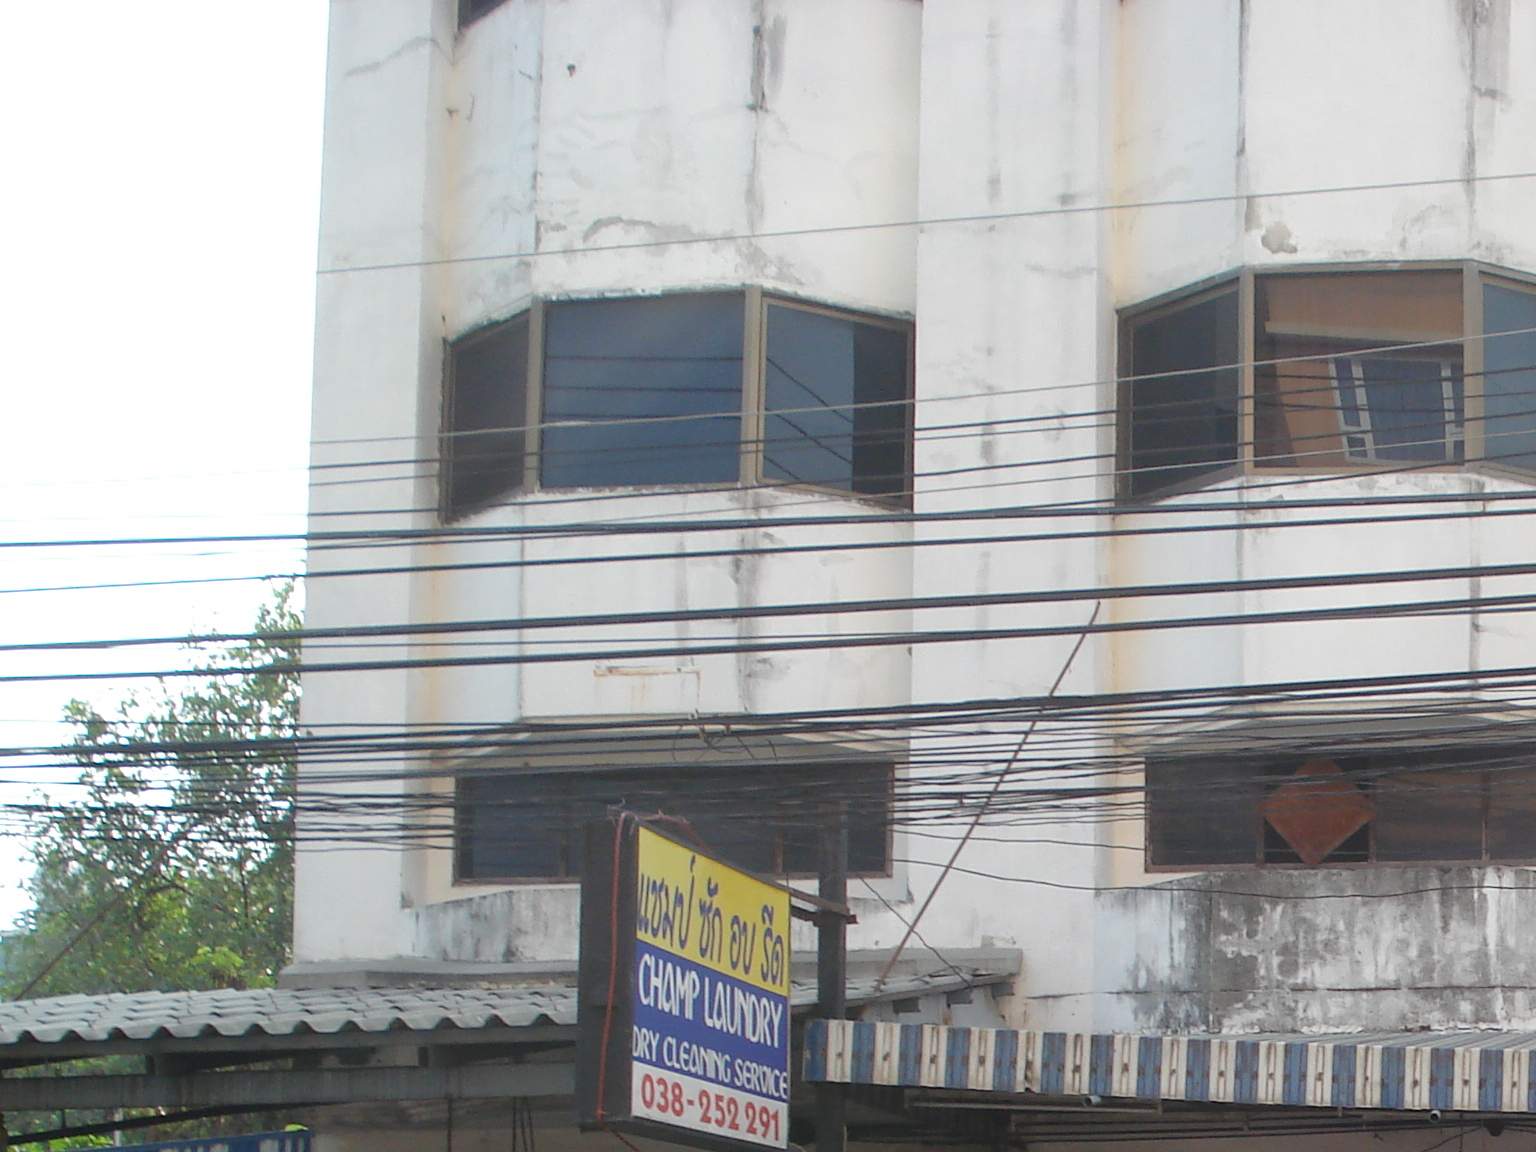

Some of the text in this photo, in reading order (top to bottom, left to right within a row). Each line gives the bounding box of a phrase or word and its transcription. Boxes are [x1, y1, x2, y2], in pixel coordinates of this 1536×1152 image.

[699, 877, 723, 963] ซัก
[730, 915, 757, 976] อบ
[761, 904, 785, 988] รีด
[638, 952, 784, 1049] CHAMP LAUNDRY
[632, 1024, 788, 1100] DRY CLEANING SERVICE
[744, 1101, 781, 1142] 291
